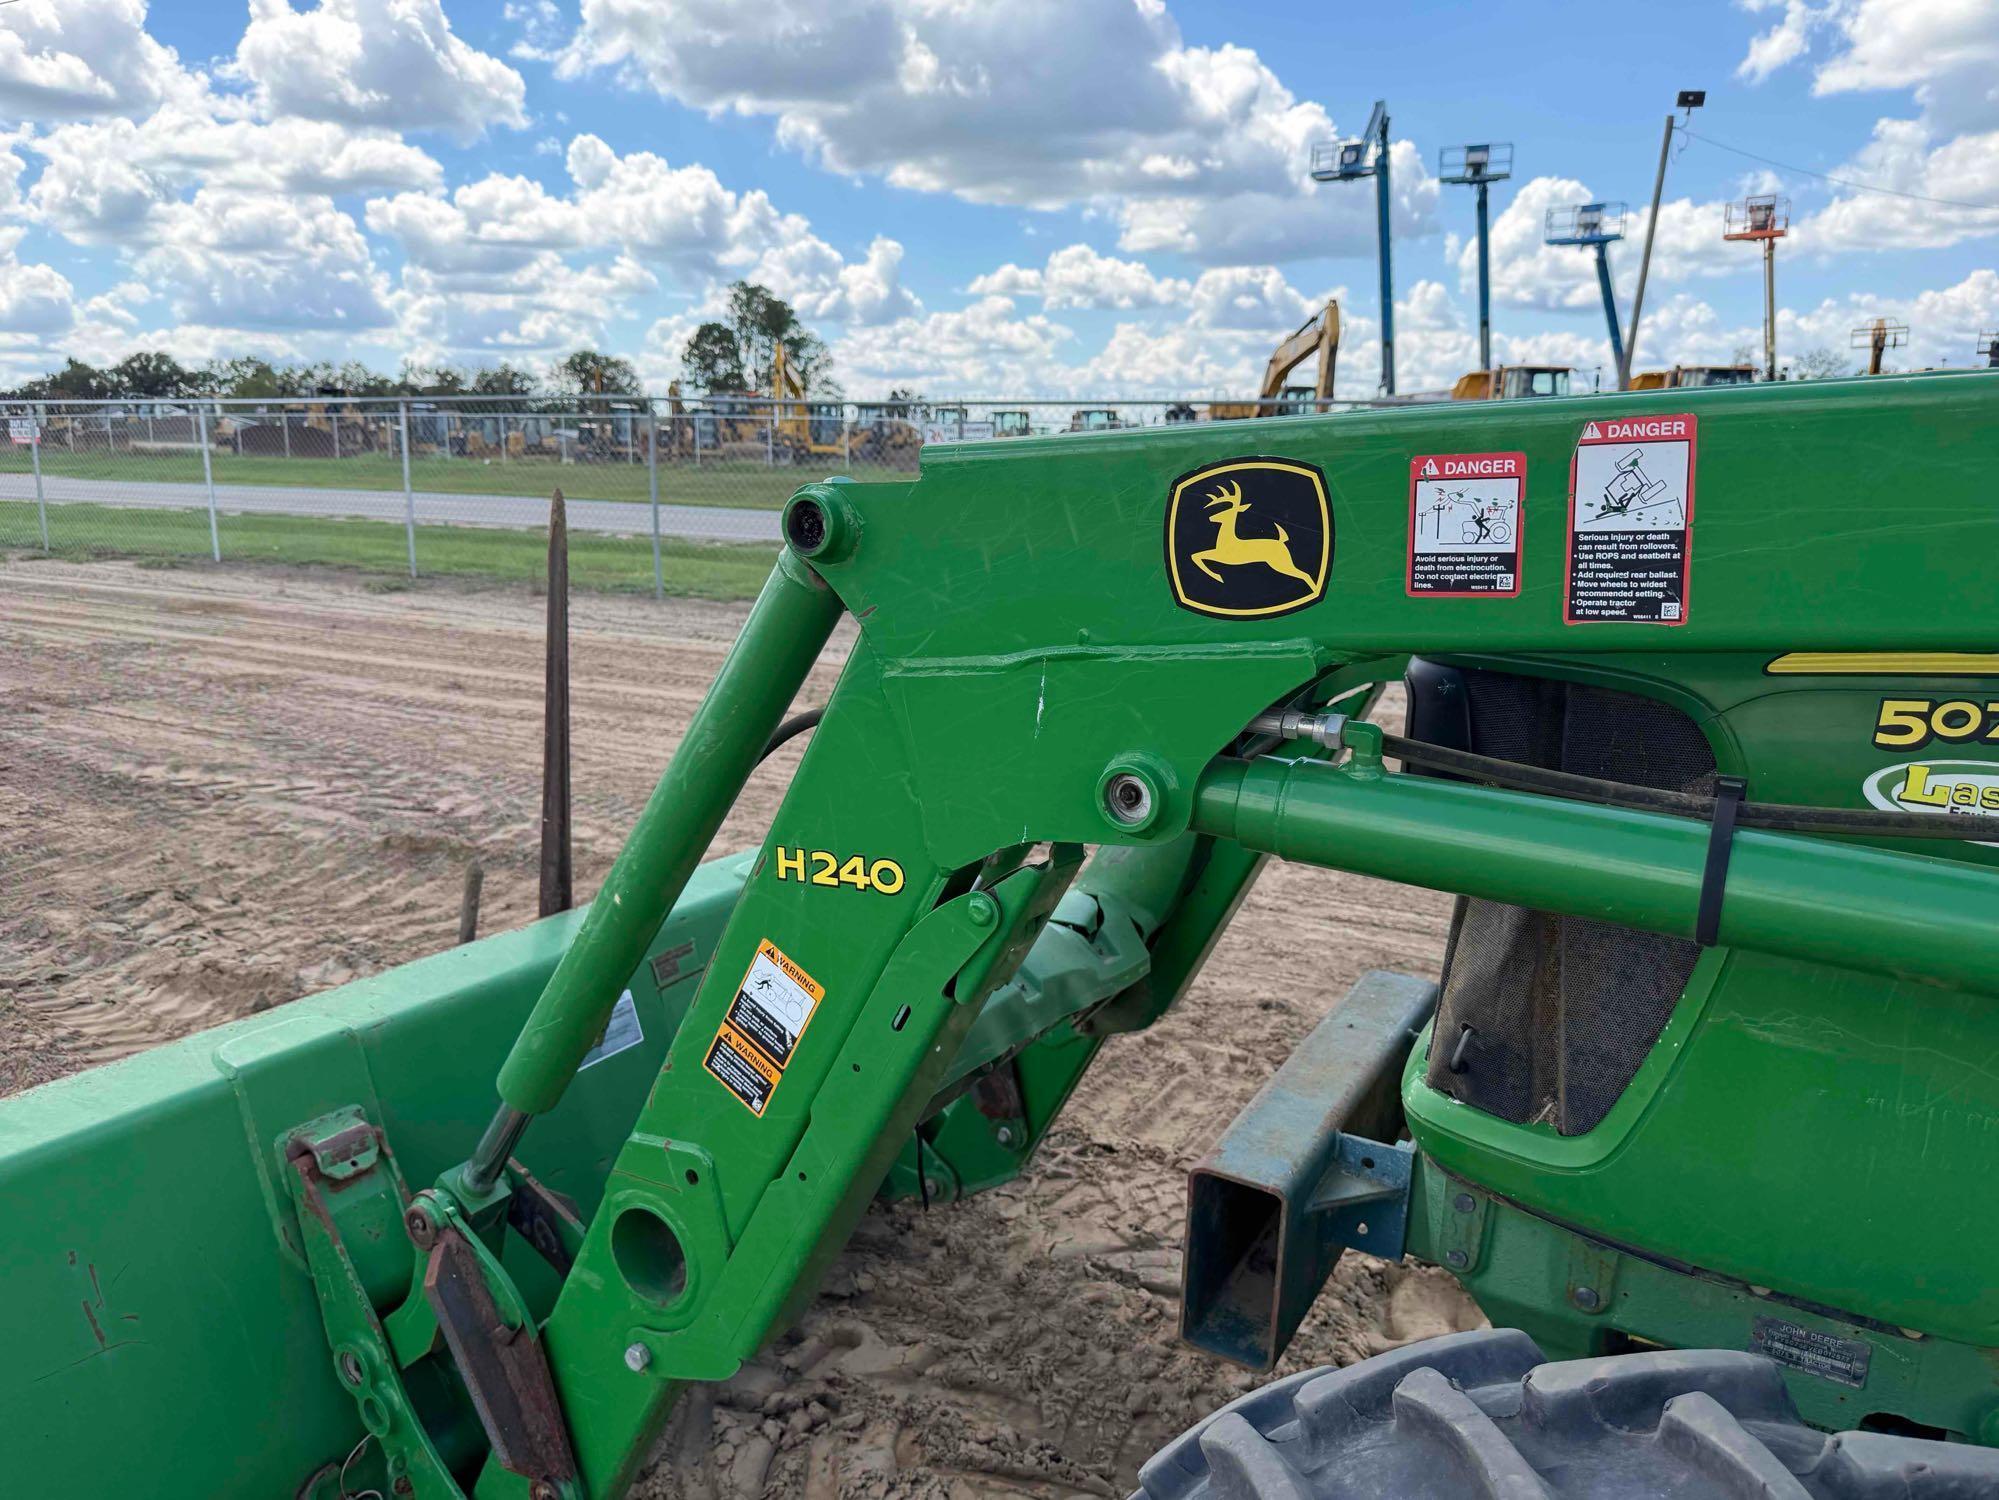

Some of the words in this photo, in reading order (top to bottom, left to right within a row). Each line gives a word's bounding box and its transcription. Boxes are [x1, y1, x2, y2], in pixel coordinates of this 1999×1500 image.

[1607, 421, 1686, 438] DANGER
[1444, 460, 1516, 475] DANGER
[1610, 533, 1633, 542] injury
[1466, 555, 1488, 563] injury
[1595, 552, 1619, 560] ROPS
[1595, 571, 1629, 580] required
[1635, 590, 1665, 599] setting.
[1576, 599, 1607, 607] Operate
[1601, 608, 1627, 616] speed.
[777, 846, 905, 894] H240
[776, 955, 816, 993] WARNING
[735, 1040, 773, 1078] WARNING
[1780, 1324, 1806, 1337] JOHN
[1810, 1333, 1844, 1347] DEERE
